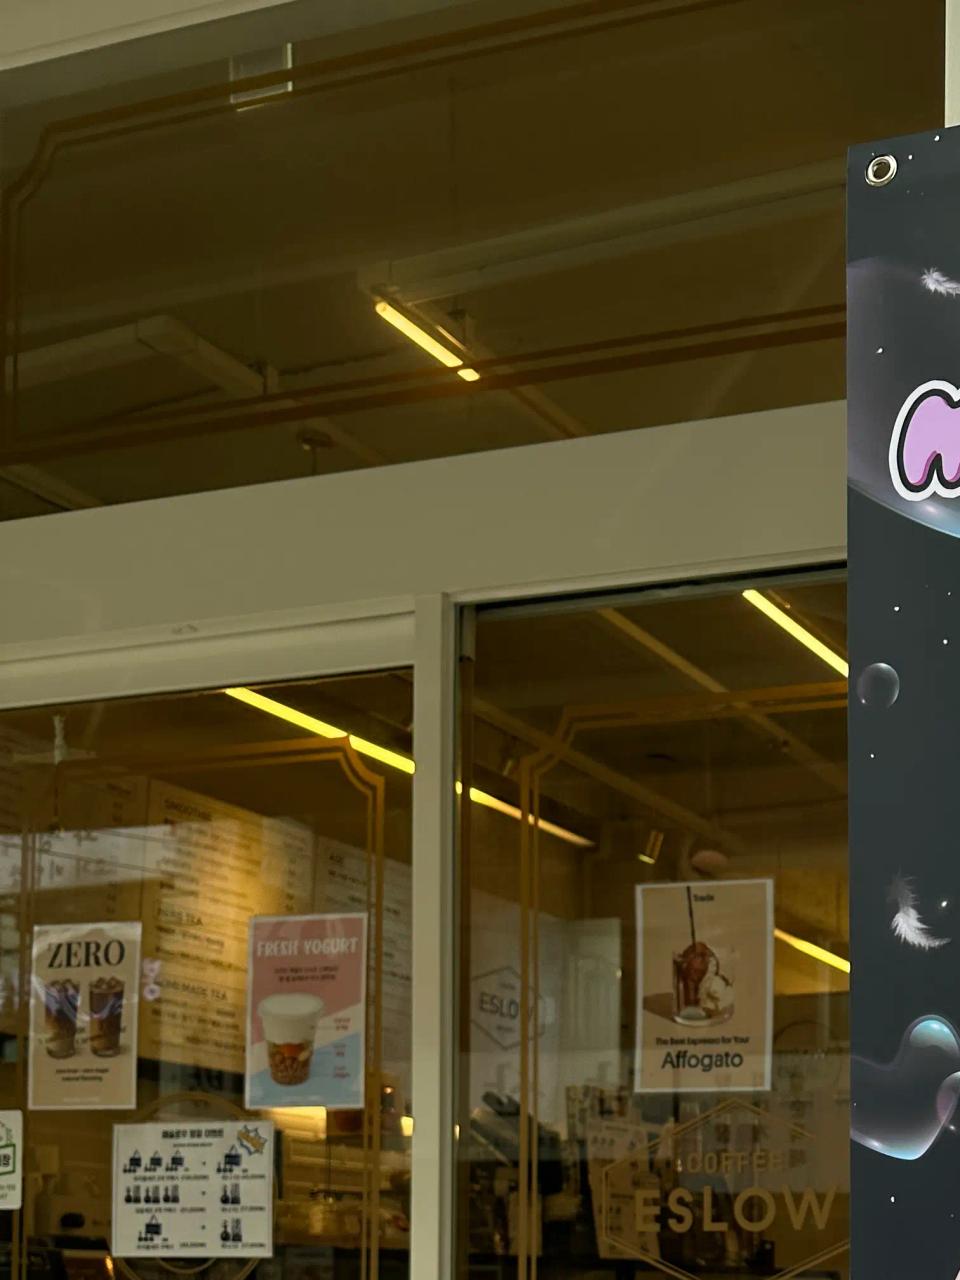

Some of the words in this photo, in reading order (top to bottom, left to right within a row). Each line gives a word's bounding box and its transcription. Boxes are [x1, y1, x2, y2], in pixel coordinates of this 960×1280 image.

[47, 939, 126, 969] ZERO
[256, 940, 299, 957] FRESH
[303, 937, 359, 955] YOGURT
[661, 1050, 744, 1072] Affogato
[686, 1150, 785, 1174] COFFEE
[635, 1184, 838, 1233] ESLOW
